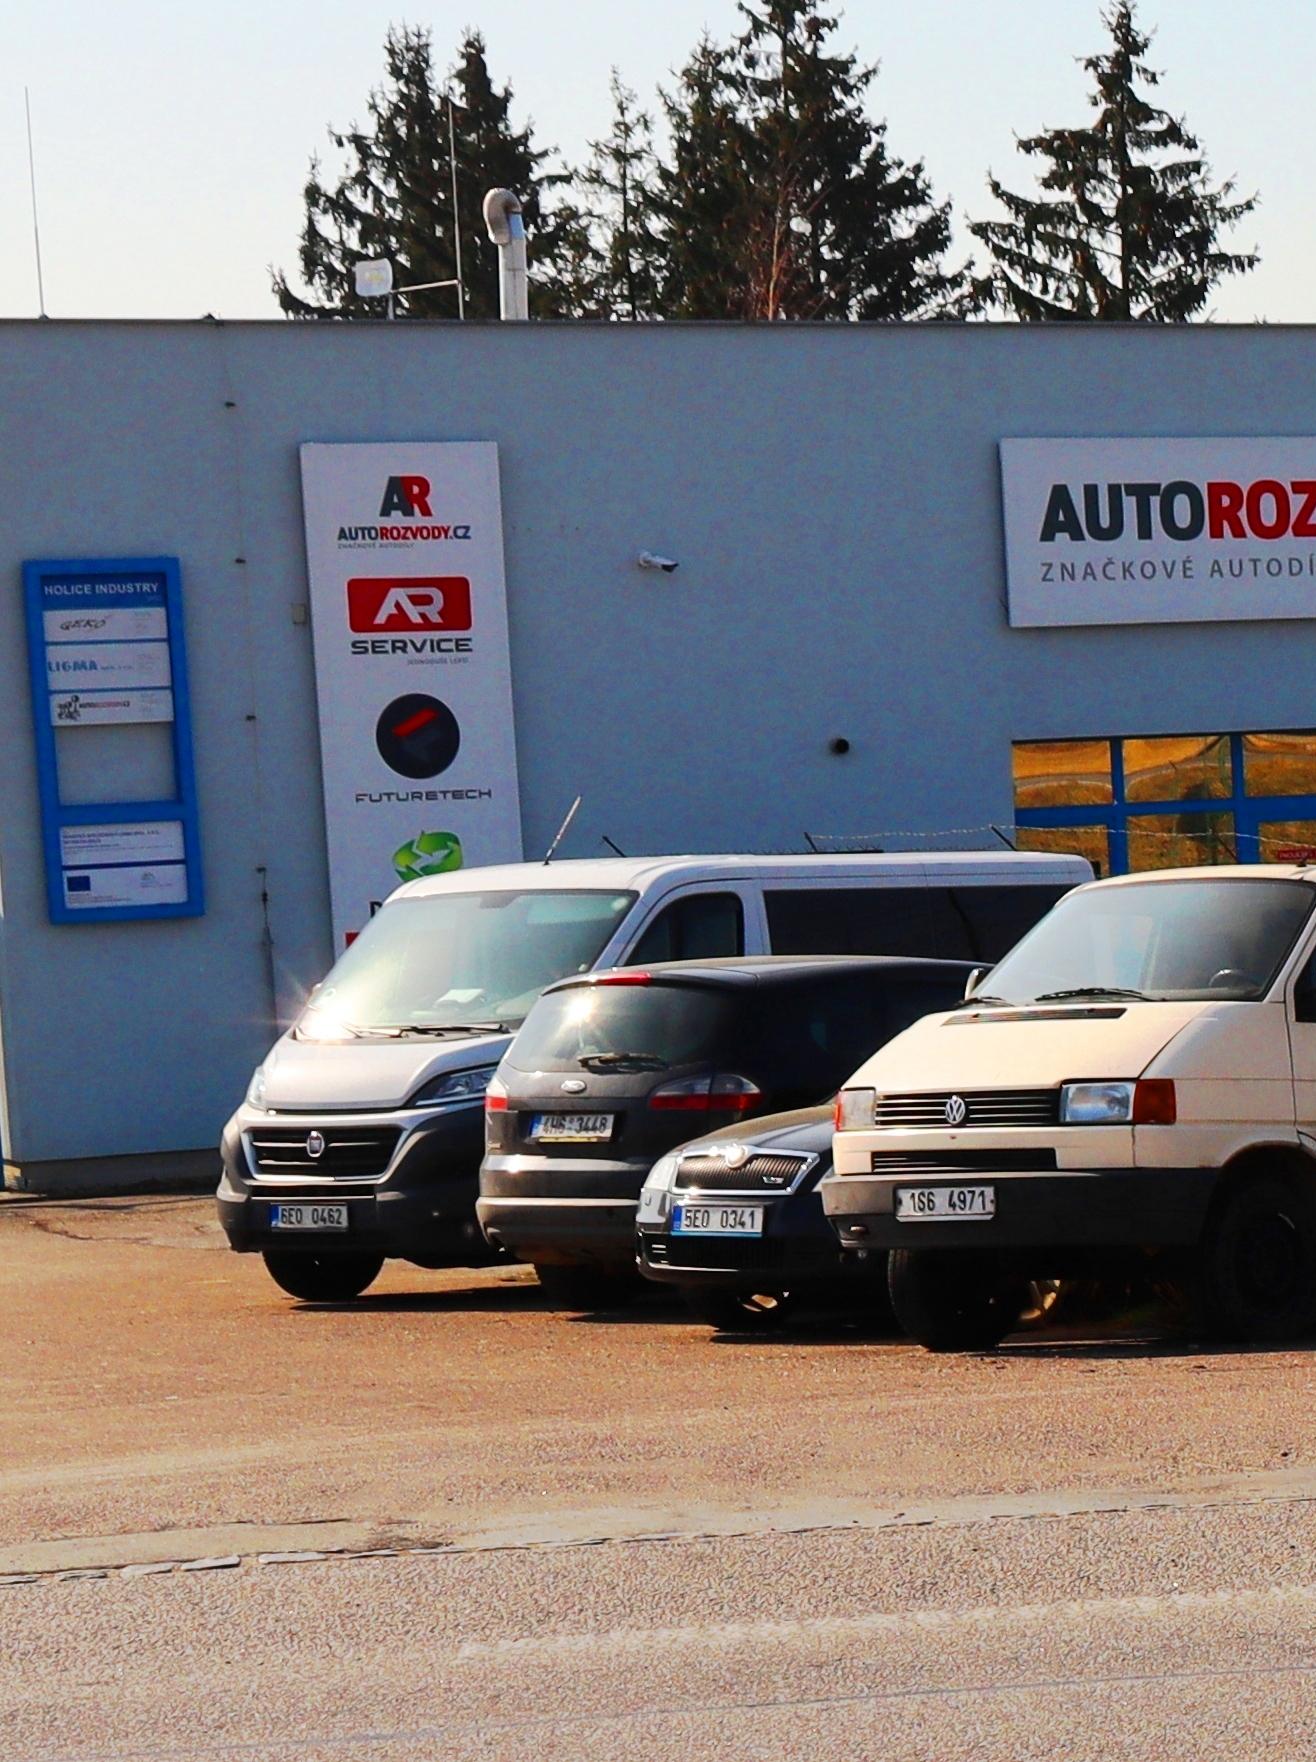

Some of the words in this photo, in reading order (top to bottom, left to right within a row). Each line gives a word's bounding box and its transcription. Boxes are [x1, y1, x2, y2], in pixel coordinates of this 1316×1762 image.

[337, 525, 472, 541] AUTOROZVODY.CZ
[1041, 554, 1194, 582] ZNAČKOVÉ
[44, 584, 92, 596] HOLICE
[95, 582, 160, 594] INDUSTRY
[351, 638, 473, 655] SERVICE
[48, 659, 98, 672] LIGMA
[355, 789, 492, 803] FUTURETECH
[910, 1191, 935, 1213] 1S6
[948, 1189, 986, 1212] 4971
[311, 1208, 342, 1225] 0462
[721, 1210, 755, 1228] 0341
